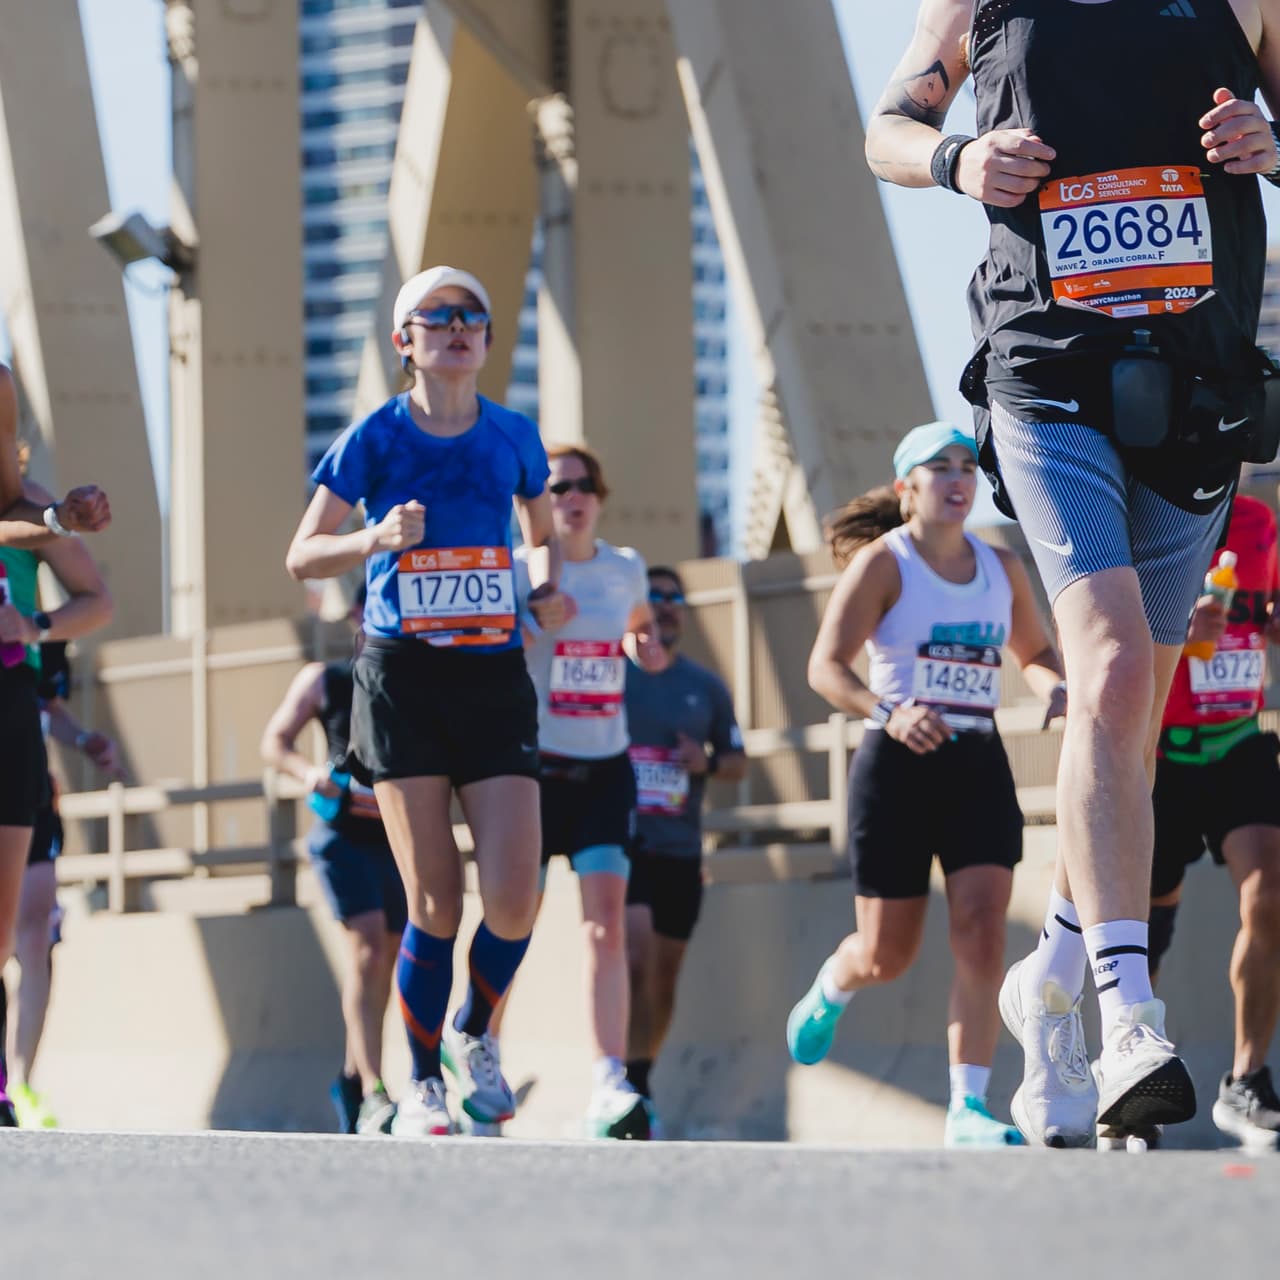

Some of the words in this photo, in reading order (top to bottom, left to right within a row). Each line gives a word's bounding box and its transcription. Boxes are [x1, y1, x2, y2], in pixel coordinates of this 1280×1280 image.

[1096, 174, 1119, 183] TATA
[1160, 184, 1185, 192] TATA
[1059, 182, 1096, 202] tcs
[1097, 179, 1148, 191] CONSULTANCY
[1098, 188, 1131, 198] SERVICES
[1052, 202, 1203, 260] 26684
[1055, 263, 1078, 272] WAVE
[1079, 260, 1088, 269] 2
[1091, 257, 1125, 267] ORANGE
[1125, 253, 1157, 263] CORRAL
[1158, 250, 1165, 261] F
[1164, 287, 1197, 299] 2024
[411, 573, 502, 605] 17705
[924, 664, 994, 696] 14824
